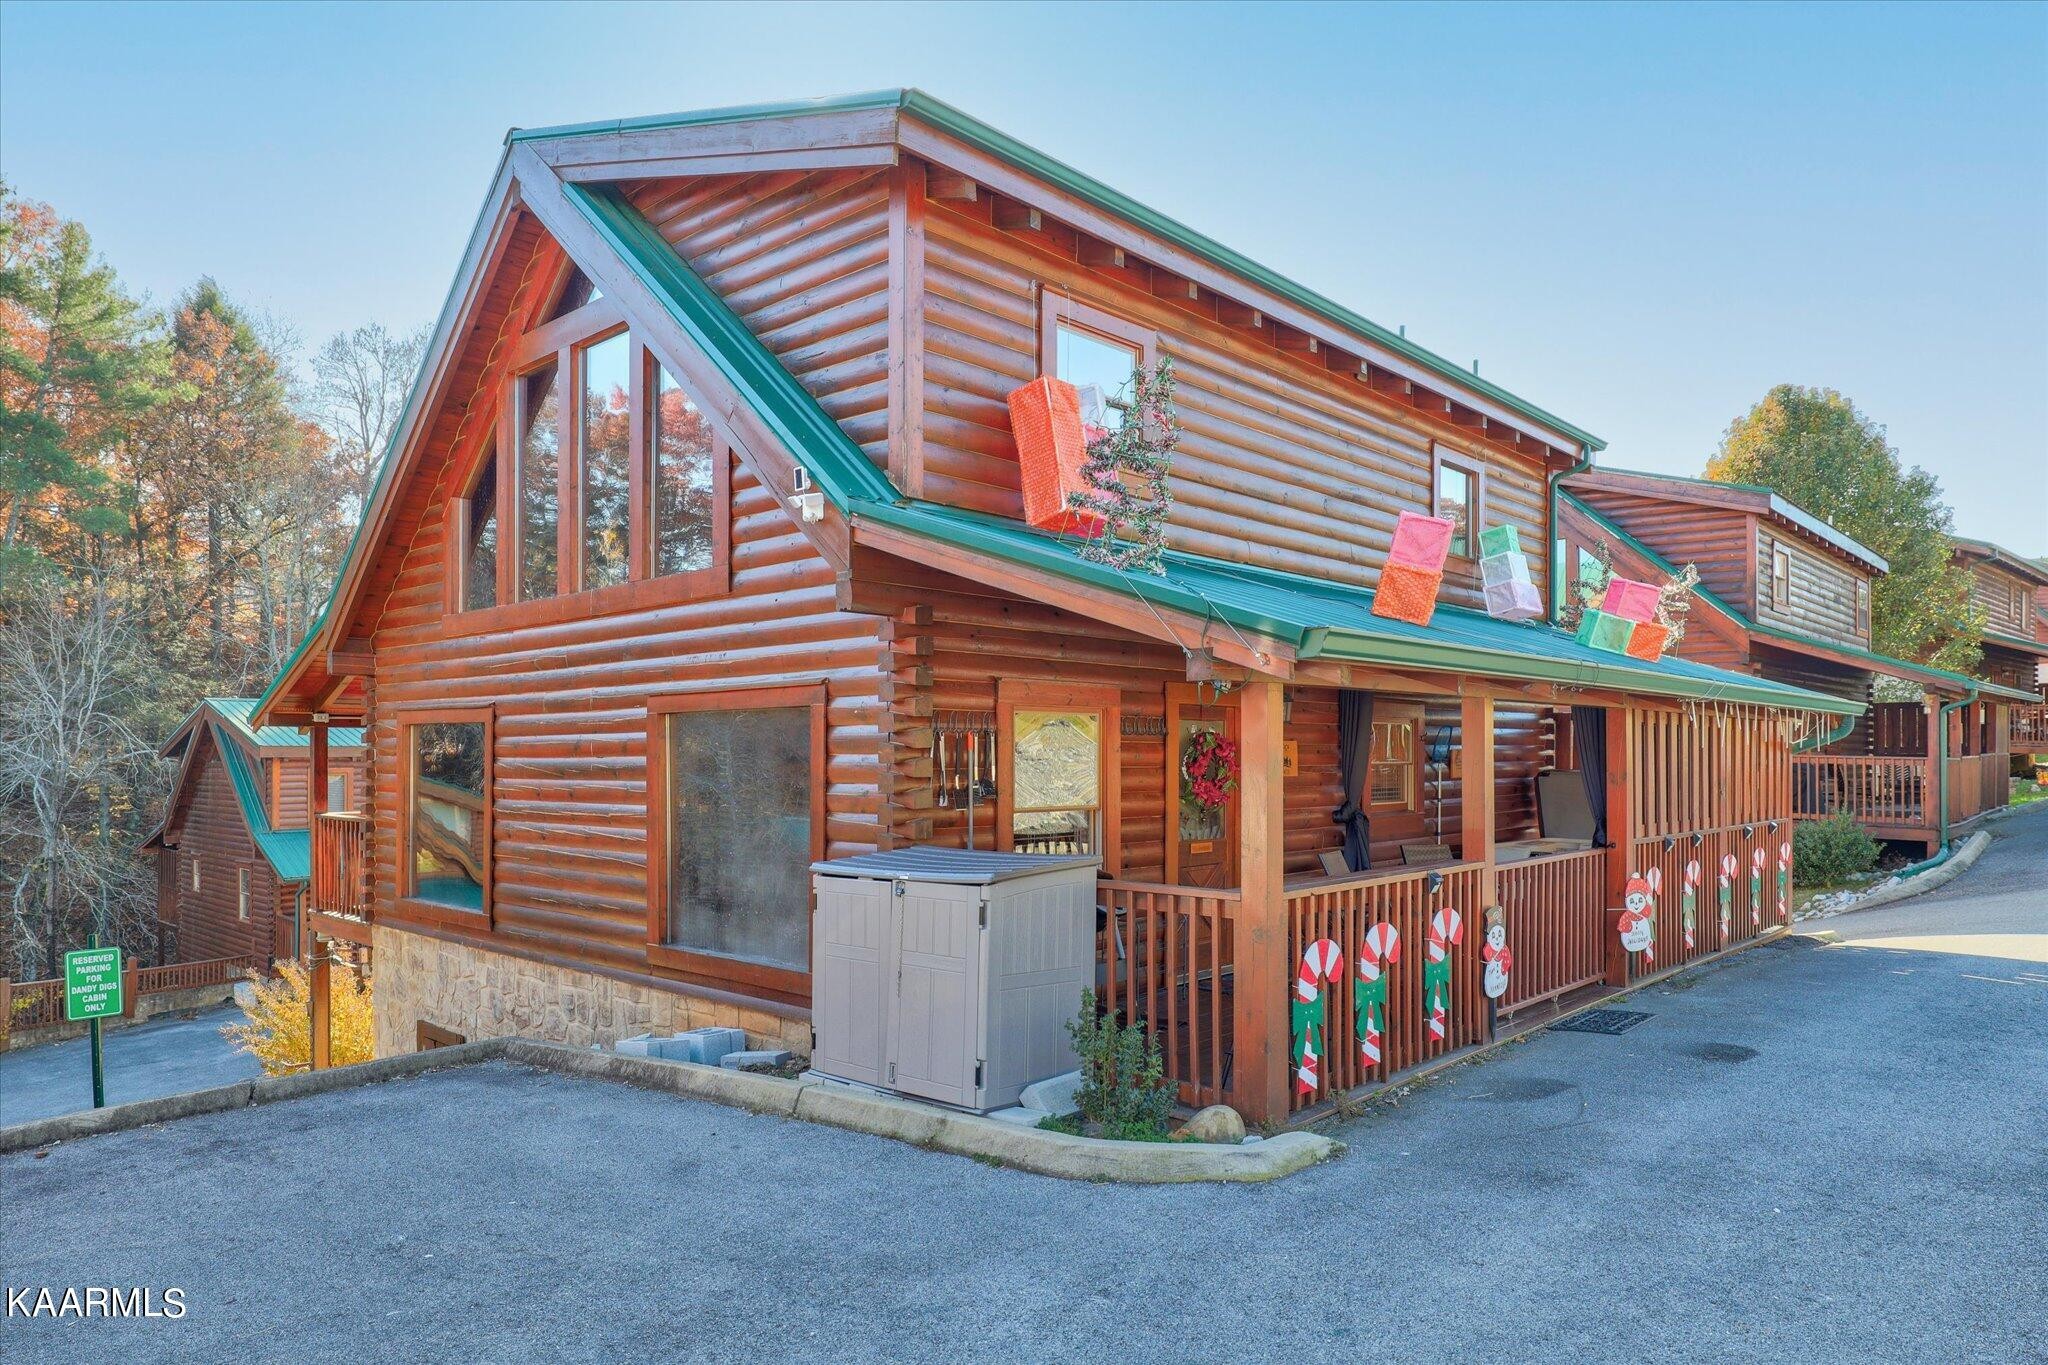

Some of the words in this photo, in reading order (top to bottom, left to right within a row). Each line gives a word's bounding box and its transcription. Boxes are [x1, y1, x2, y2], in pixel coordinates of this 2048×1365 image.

[72, 954, 114, 965] RESERVED
[76, 964, 111, 974] PARKING
[86, 975, 102, 983] FOR
[72, 984, 97, 994] DANDY
[100, 982, 117, 991] DIGS
[82, 993, 107, 1002] CABIN
[84, 1003, 106, 1012] ONLY
